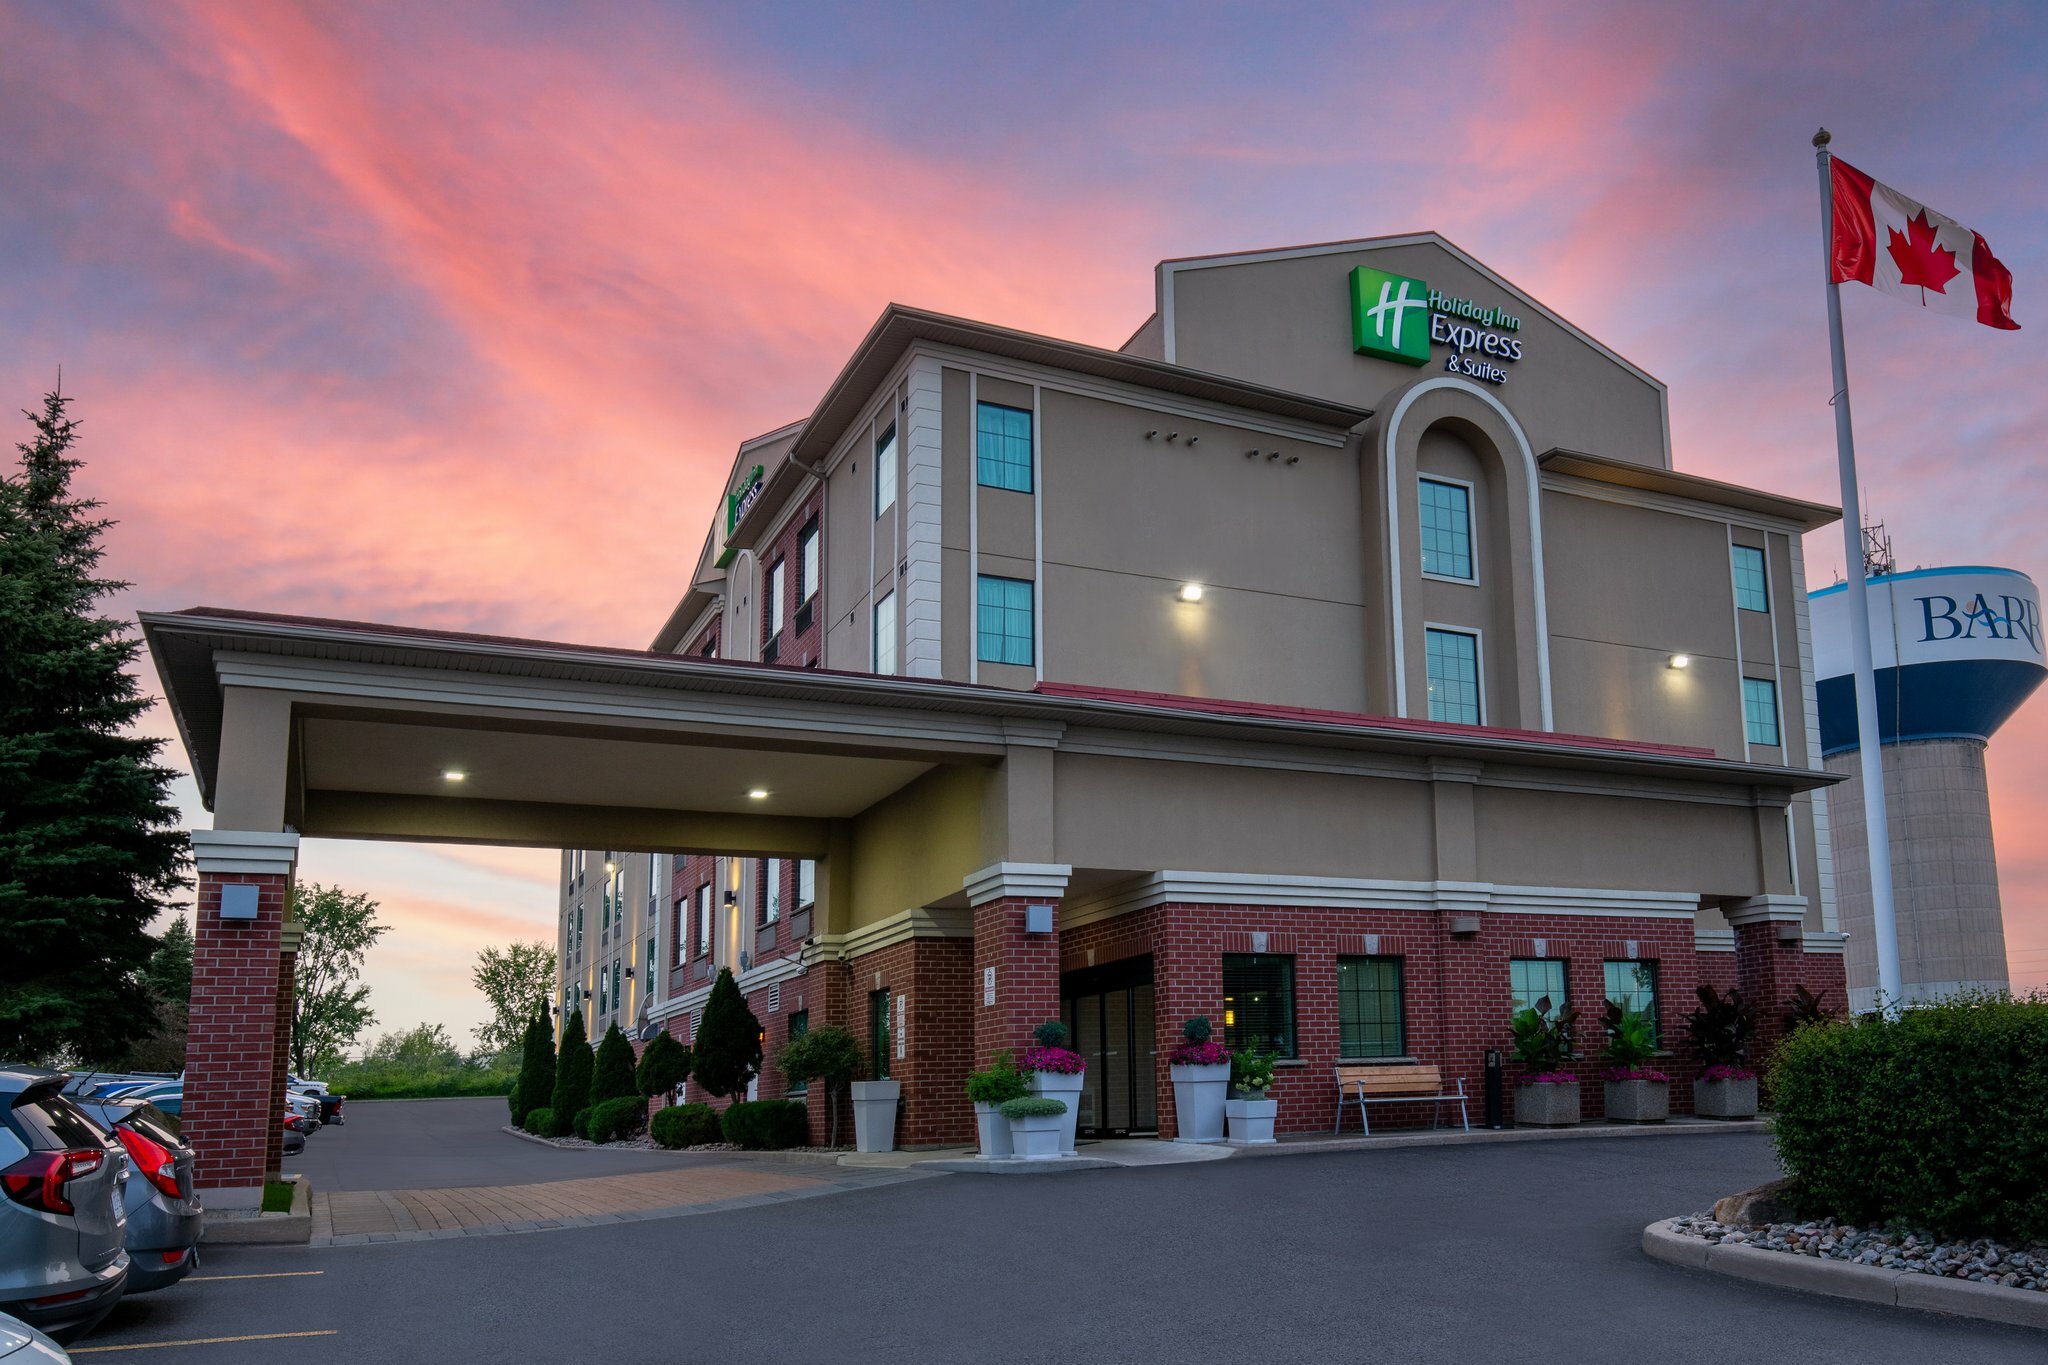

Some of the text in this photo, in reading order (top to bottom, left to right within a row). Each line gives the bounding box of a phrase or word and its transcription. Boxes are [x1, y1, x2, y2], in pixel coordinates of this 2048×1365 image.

[1429, 288, 1521, 330] Holiday Inn
[1431, 313, 1522, 360] Express
[1448, 354, 1507, 384] & Suites
